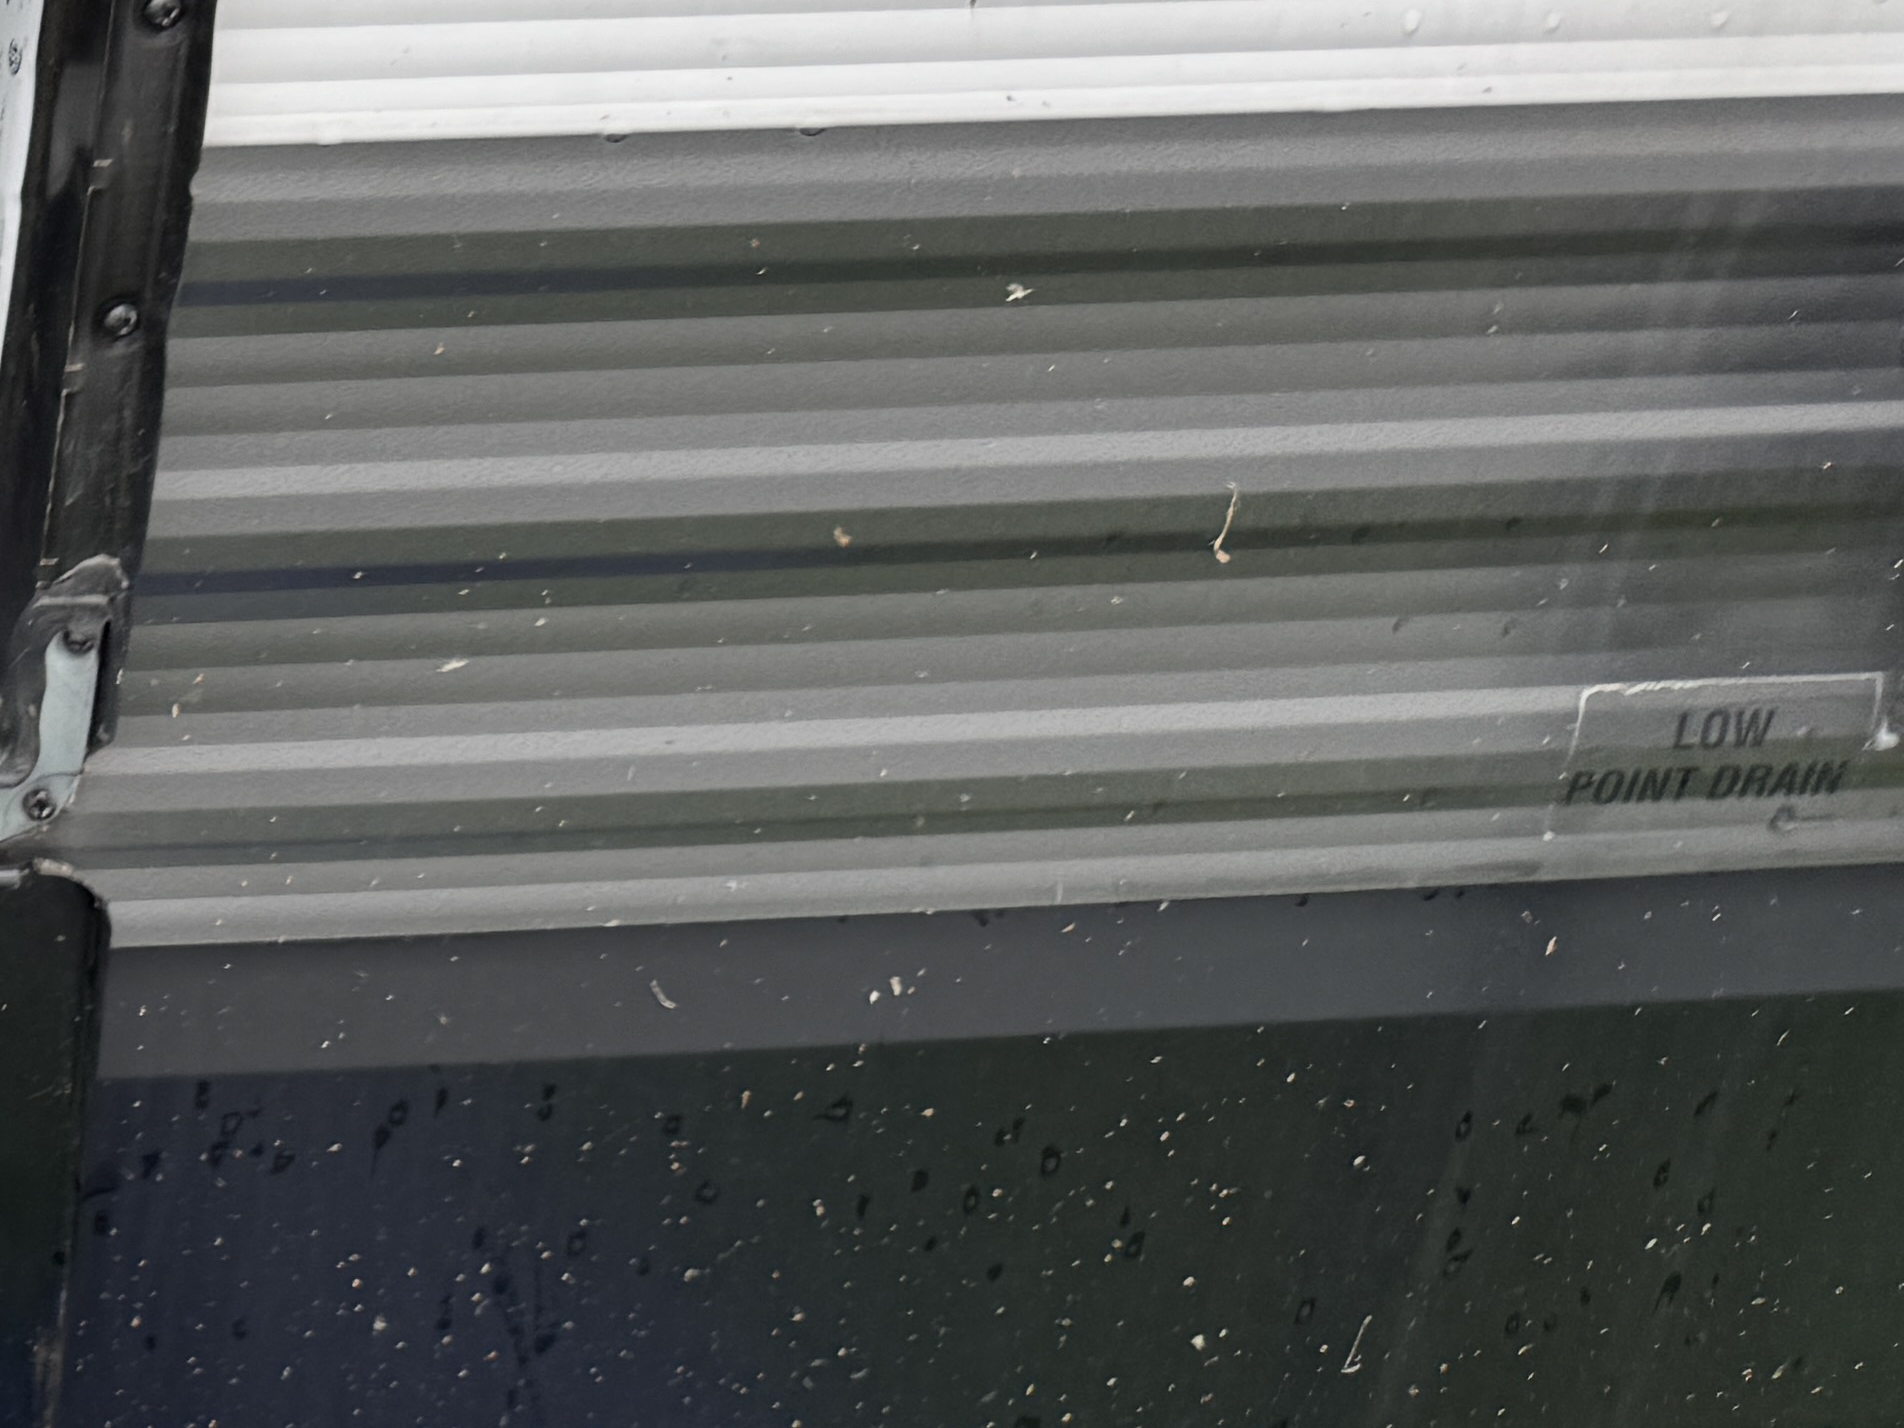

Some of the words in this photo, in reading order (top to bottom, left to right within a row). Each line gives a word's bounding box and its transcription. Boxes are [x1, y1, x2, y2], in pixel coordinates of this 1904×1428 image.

[1675, 708, 1775, 748] LOW
[1565, 768, 1698, 806] POINT
[1708, 762, 1849, 799] DRAIN
